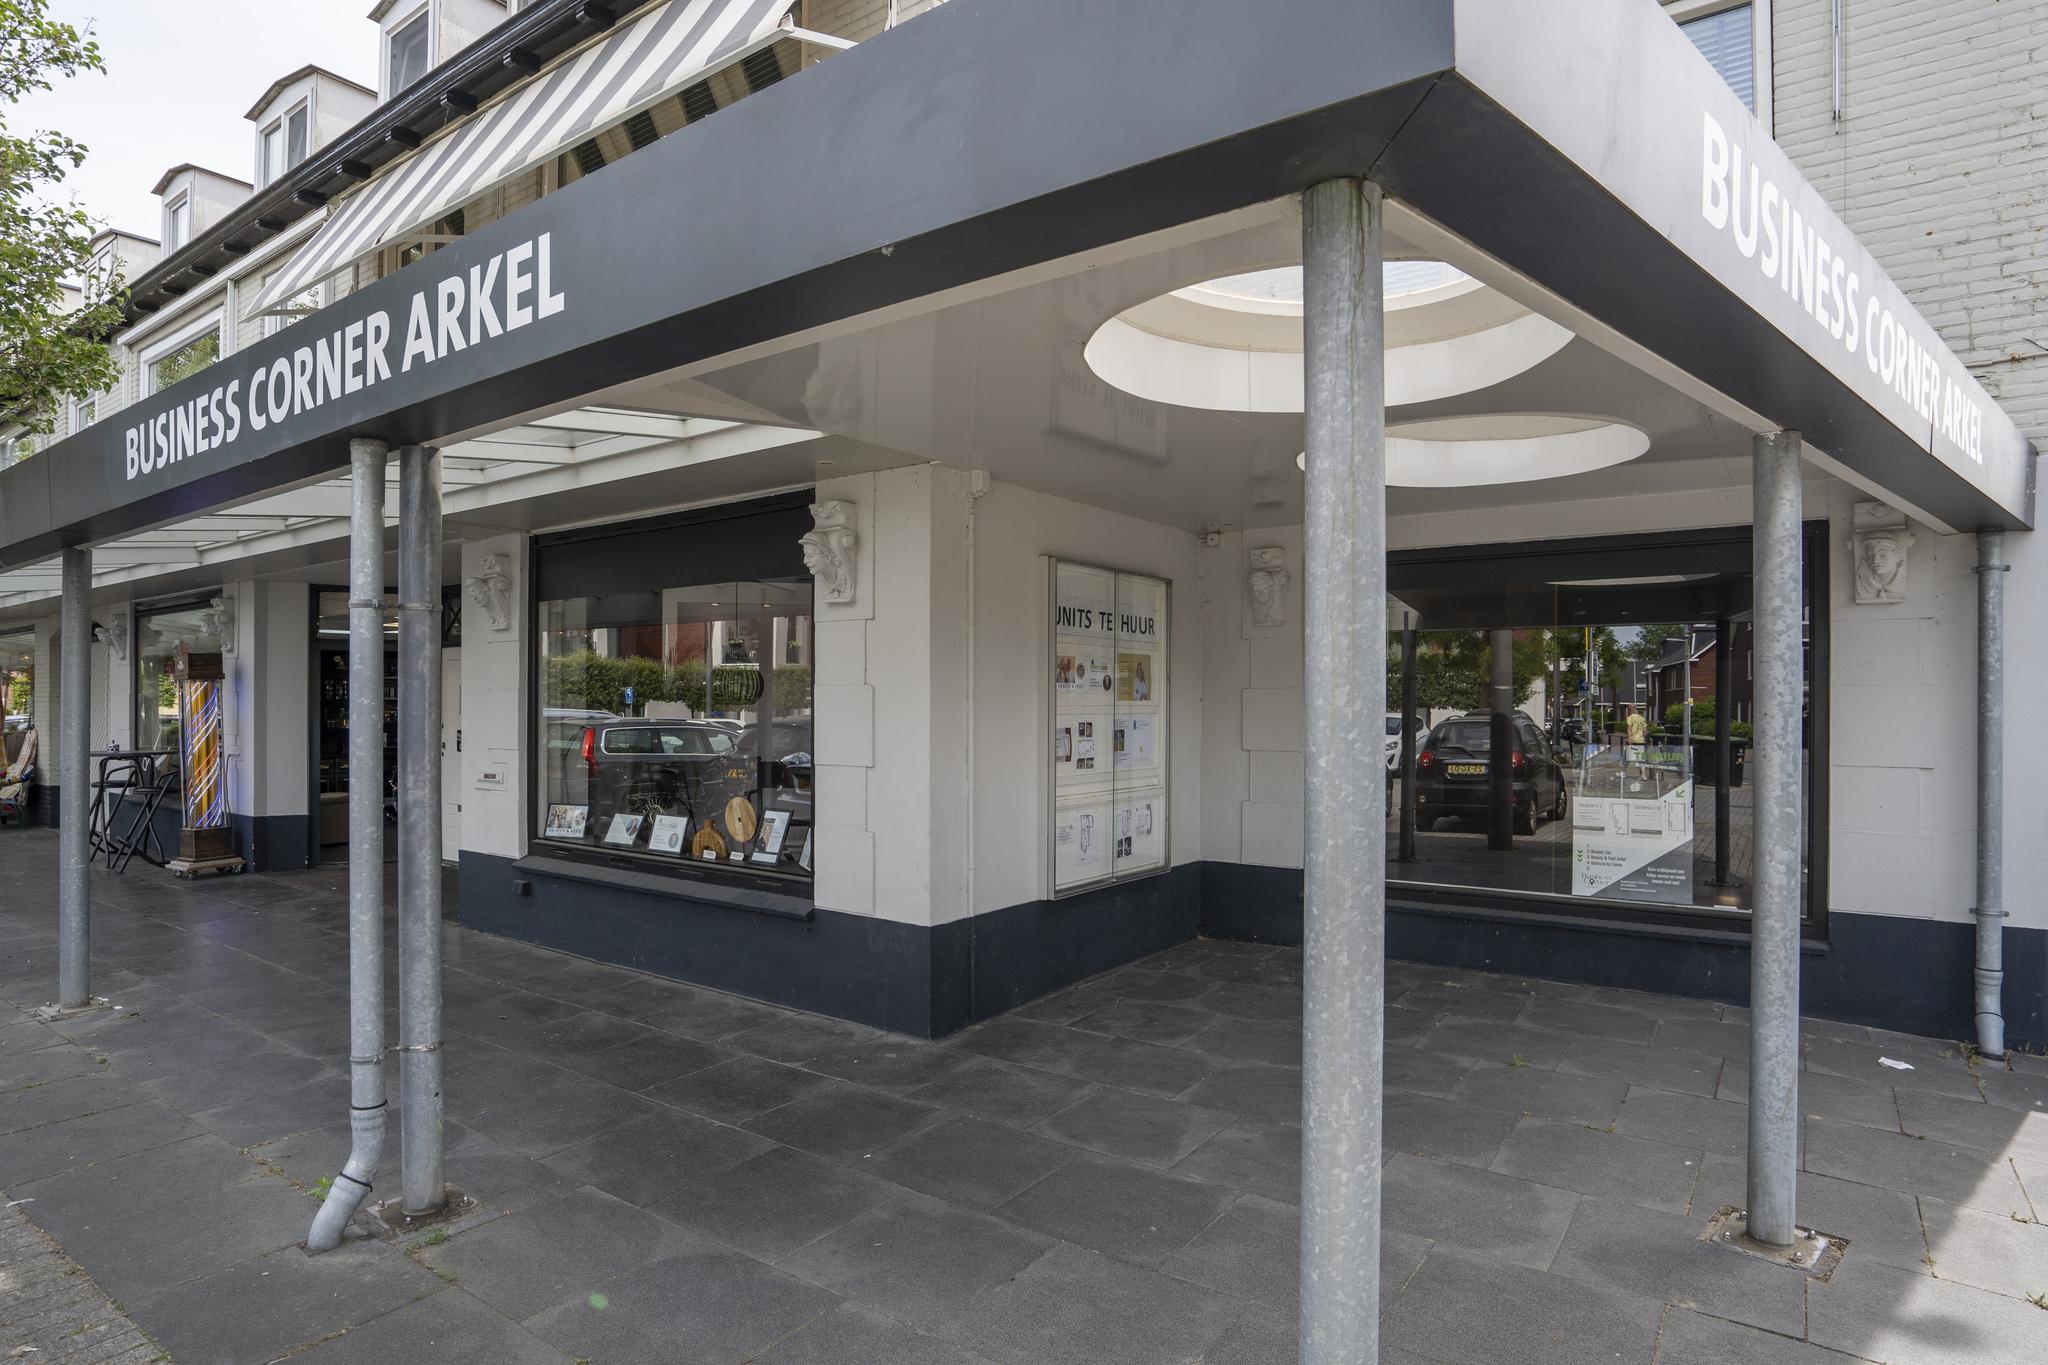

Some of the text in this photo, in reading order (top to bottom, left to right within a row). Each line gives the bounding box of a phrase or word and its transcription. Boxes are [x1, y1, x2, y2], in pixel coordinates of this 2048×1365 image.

[125, 231, 565, 481] BUSINESS CORNER ARKEL
[1702, 110, 1983, 465] BUSINESS CORNER ARKEL
[1099, 611, 1113, 631] TE
[1121, 614, 1155, 635] HUUR
